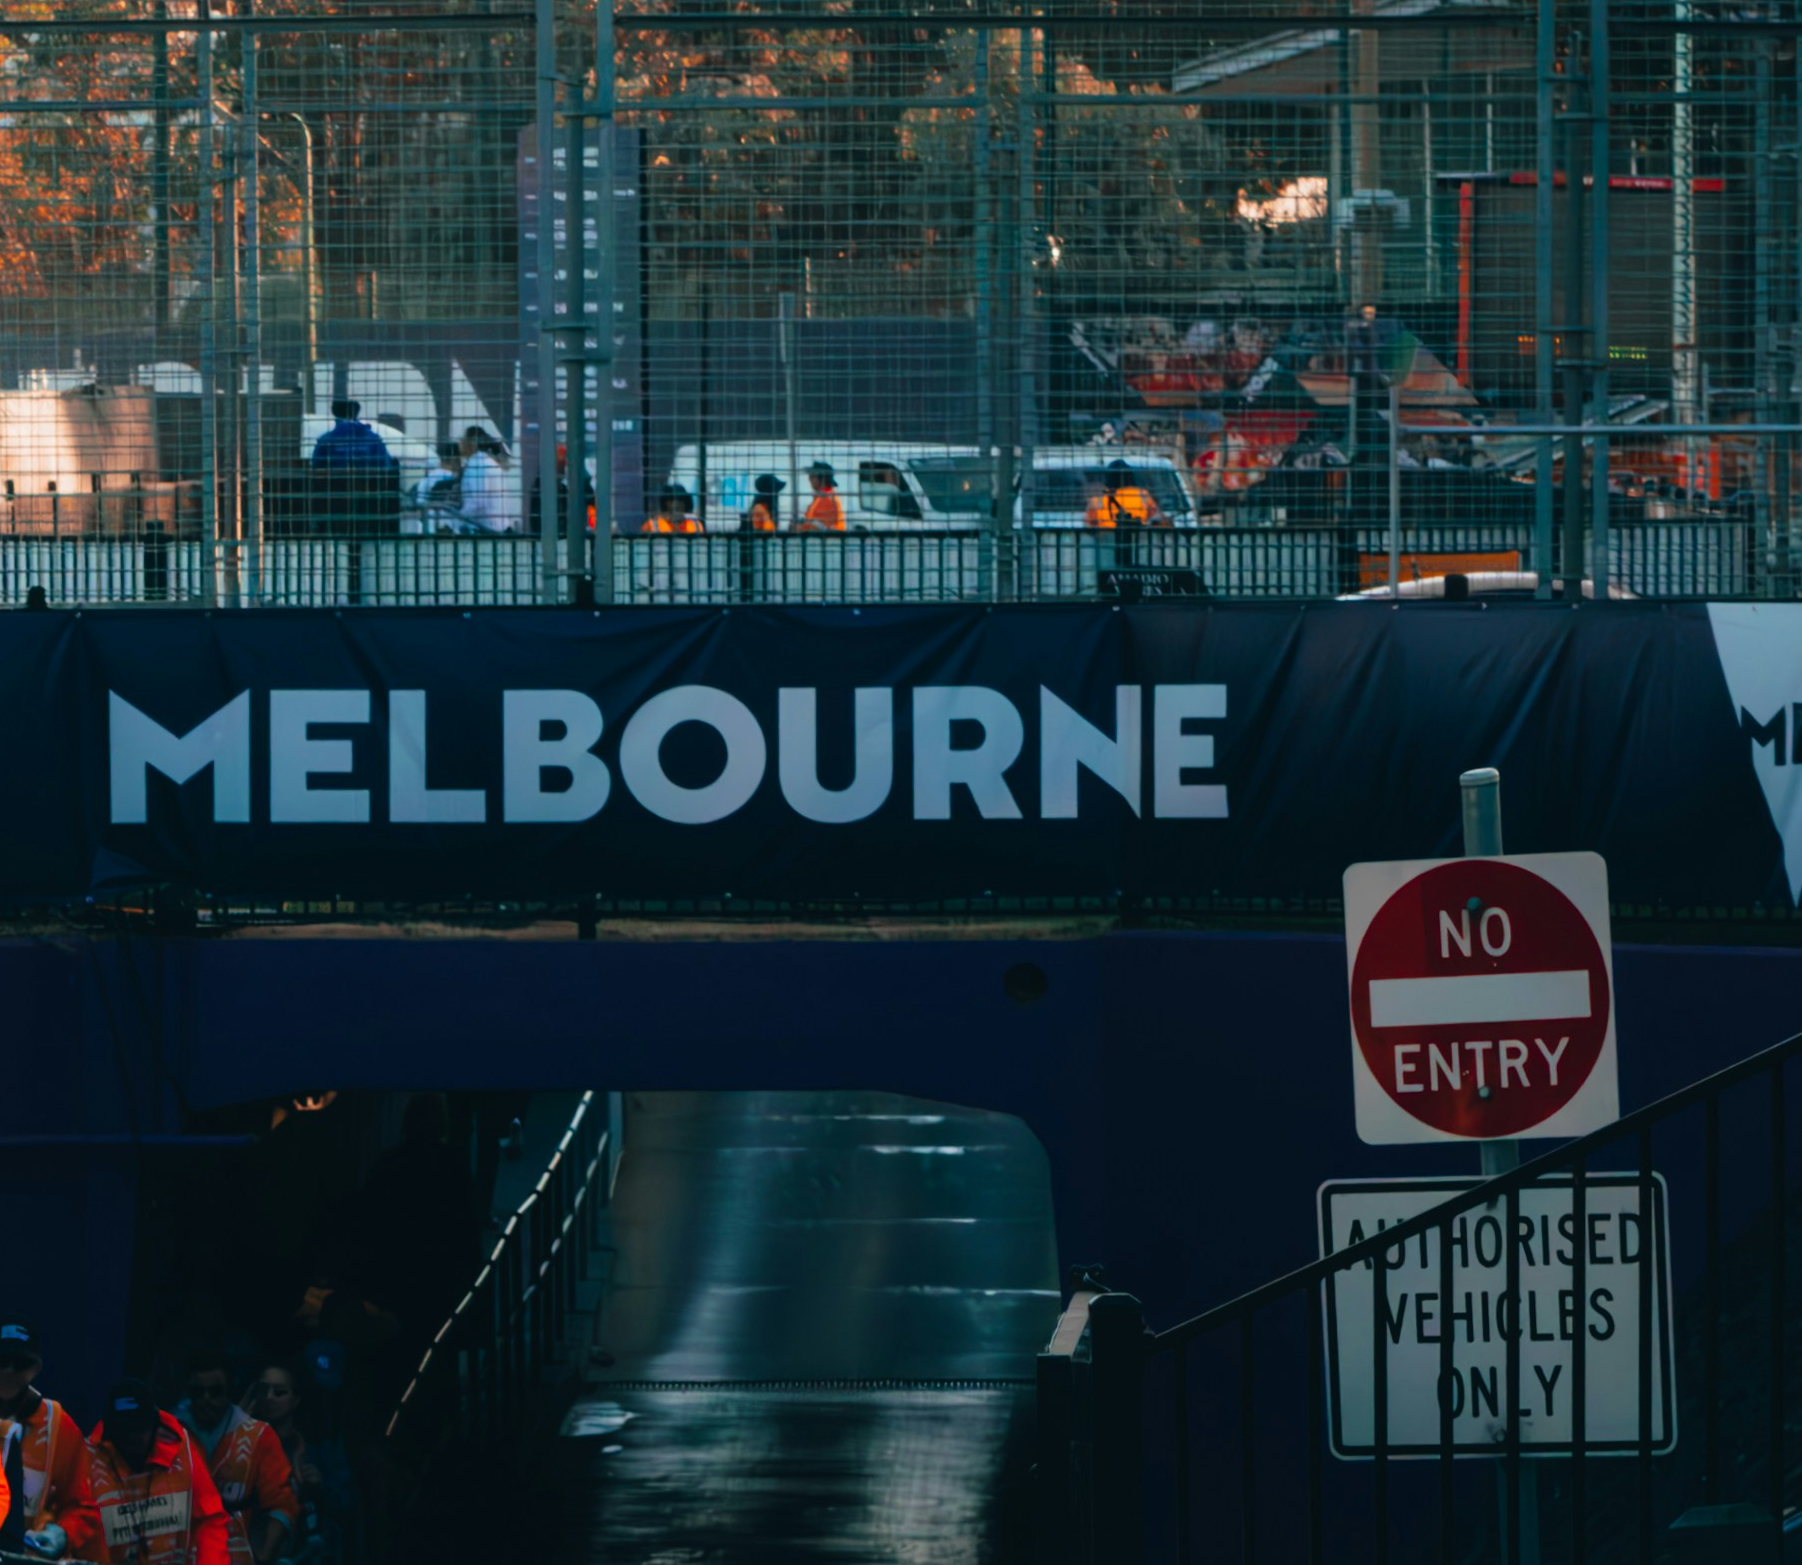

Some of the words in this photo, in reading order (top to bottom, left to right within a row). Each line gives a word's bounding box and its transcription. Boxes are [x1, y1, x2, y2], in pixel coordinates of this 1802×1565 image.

[109, 684, 1228, 824] MELBOURNE
[1438, 906, 1512, 958] NO
[1393, 1037, 1570, 1093] ENTRY
[1437, 1364, 1563, 1420] ONY
